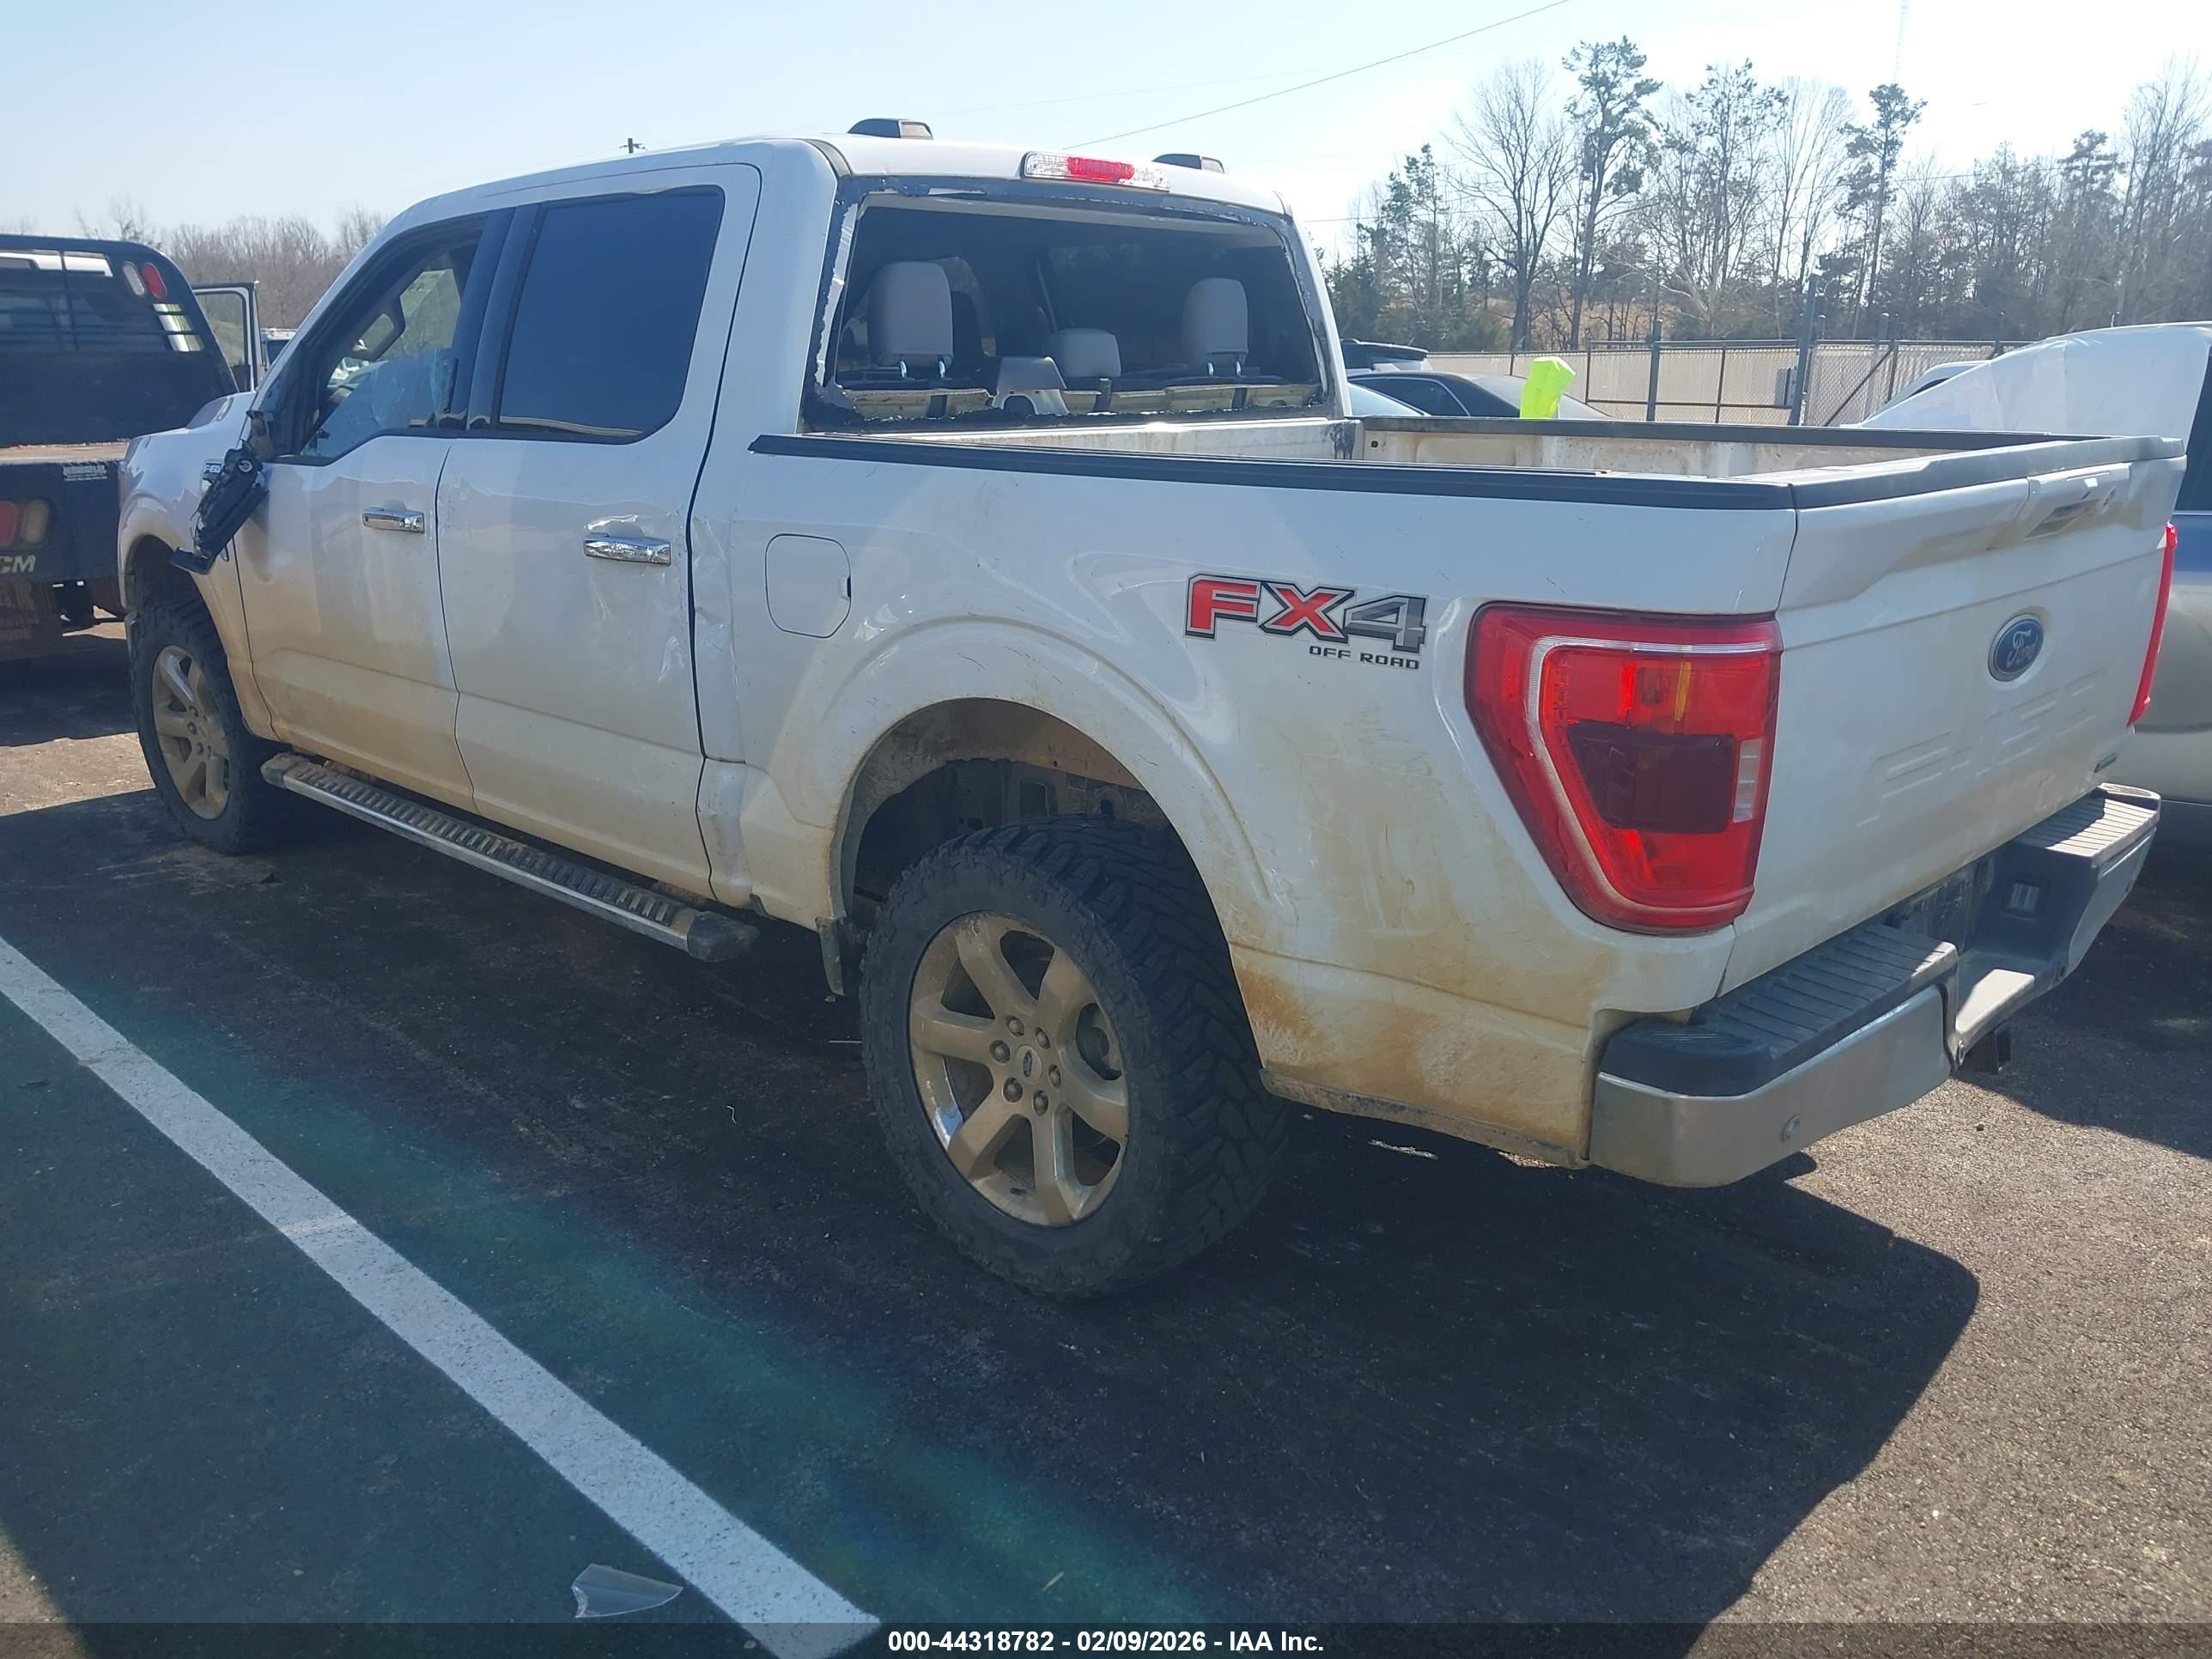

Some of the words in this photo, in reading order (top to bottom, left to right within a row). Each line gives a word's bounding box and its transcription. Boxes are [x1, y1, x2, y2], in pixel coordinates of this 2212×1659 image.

[1184, 573, 1427, 653] FX4
[1309, 645, 1352, 659] OFF
[1359, 652, 1419, 670] ROAD
